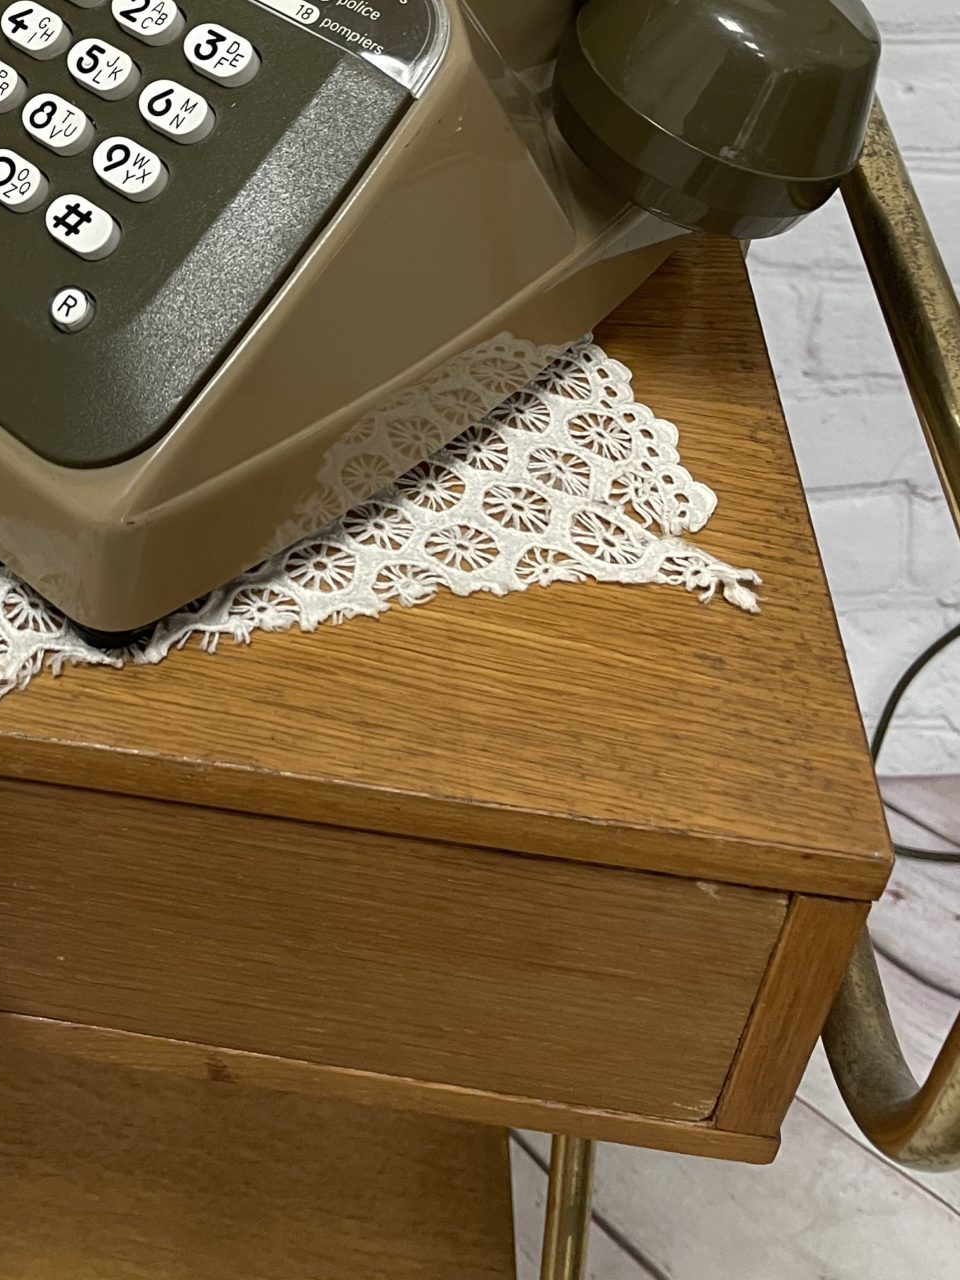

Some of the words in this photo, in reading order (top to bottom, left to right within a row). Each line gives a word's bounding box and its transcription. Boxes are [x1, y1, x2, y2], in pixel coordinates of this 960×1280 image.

[8, 8, 34, 34] 4
[295, 3, 314, 21] 18
[319, 16, 385, 55] pompiers
[76, 44, 106, 74] 5
[194, 30, 227, 60] 3
[29, 100, 58, 129] 8
[147, 88, 174, 117] 6
[103, 144, 131, 172] 9
[57, 294, 78, 317] R
